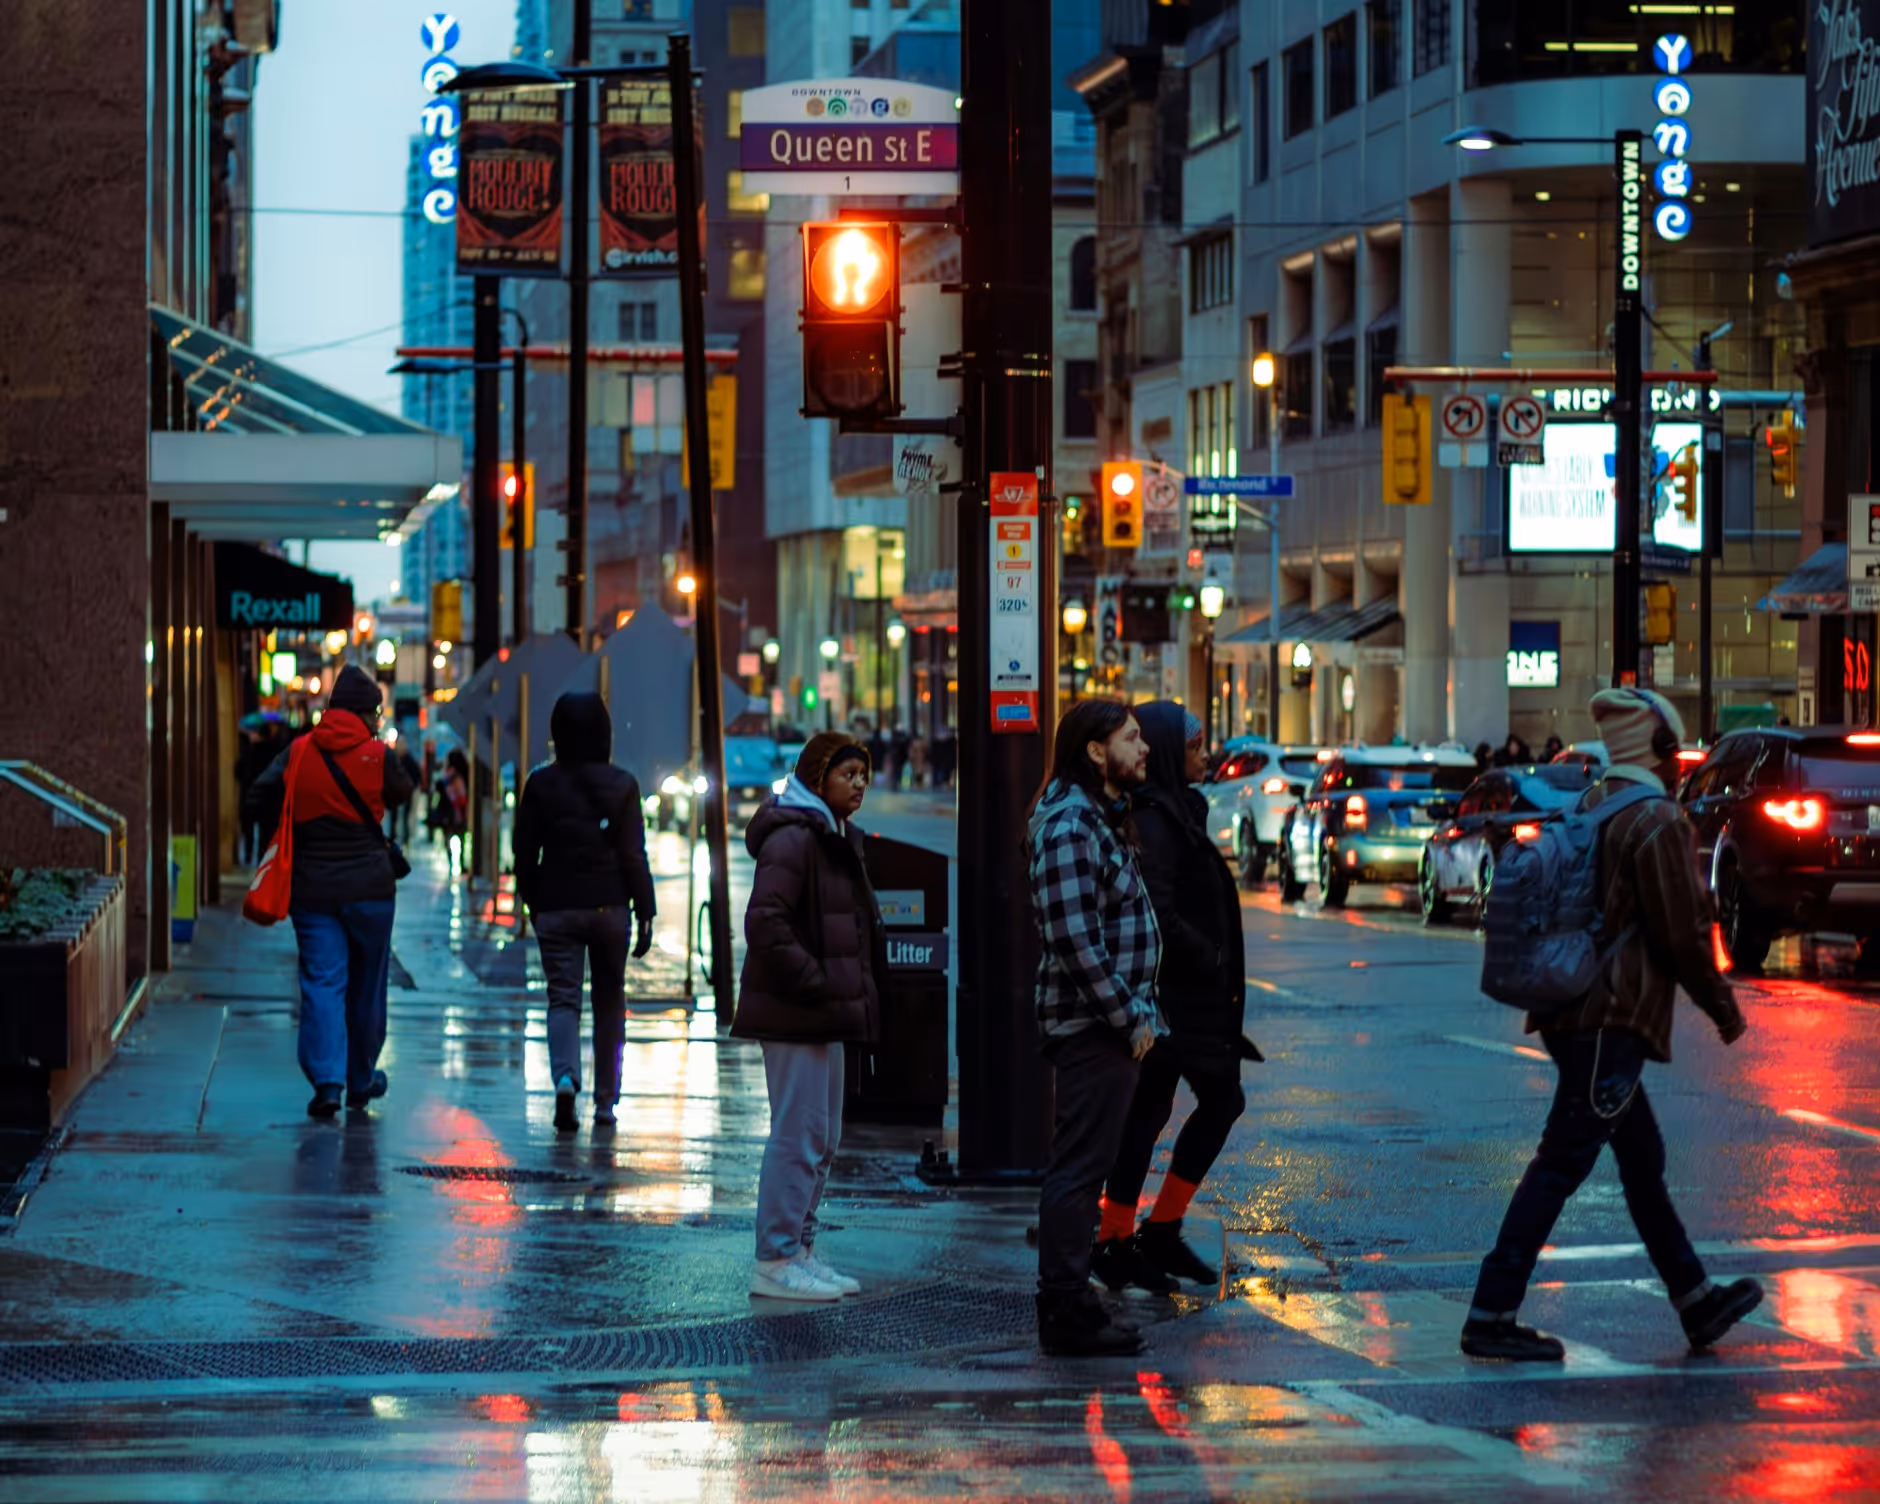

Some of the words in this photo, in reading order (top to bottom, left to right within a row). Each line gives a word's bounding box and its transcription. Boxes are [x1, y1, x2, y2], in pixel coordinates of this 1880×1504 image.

[791, 88, 861, 97] DOWNTOWN
[421, 13, 460, 225] Yonge
[770, 129, 873, 165] Queen
[885, 136, 908, 162] St
[917, 130, 932, 162] E
[1653, 33, 1693, 241] Yonge
[844, 176, 850, 192] 1
[1622, 141, 1640, 291] DOWNTOWN
[1007, 577, 1022, 589] 97
[230, 590, 321, 625] Rexall
[887, 941, 933, 964] Litter
